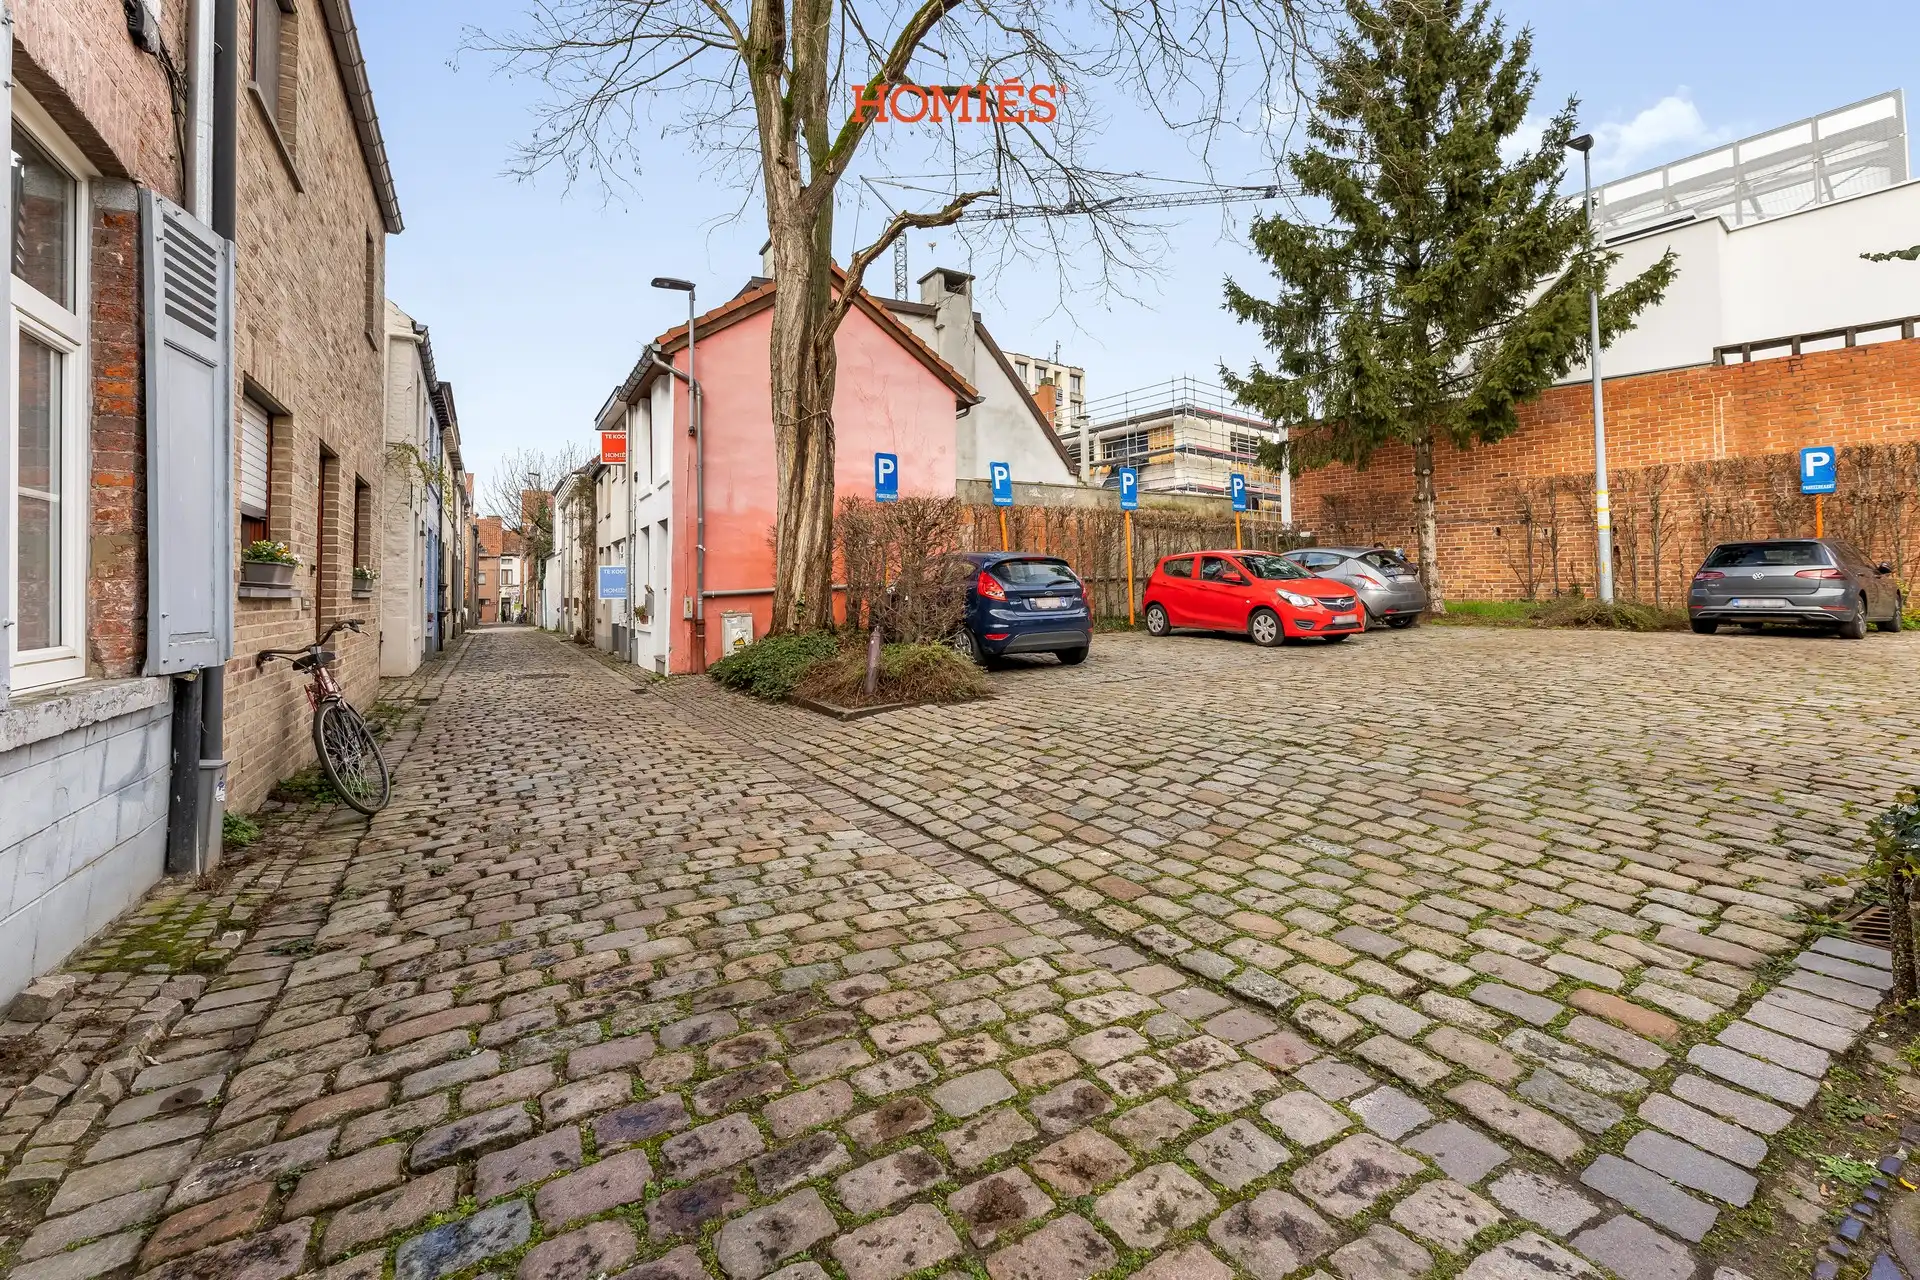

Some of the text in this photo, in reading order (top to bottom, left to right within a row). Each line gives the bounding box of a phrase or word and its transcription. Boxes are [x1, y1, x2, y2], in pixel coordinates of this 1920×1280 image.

[878, 458, 895, 484] P
[1805, 452, 1830, 477] P
[993, 466, 1008, 490] P
[1122, 472, 1135, 495] P
[1233, 477, 1244, 498] P
